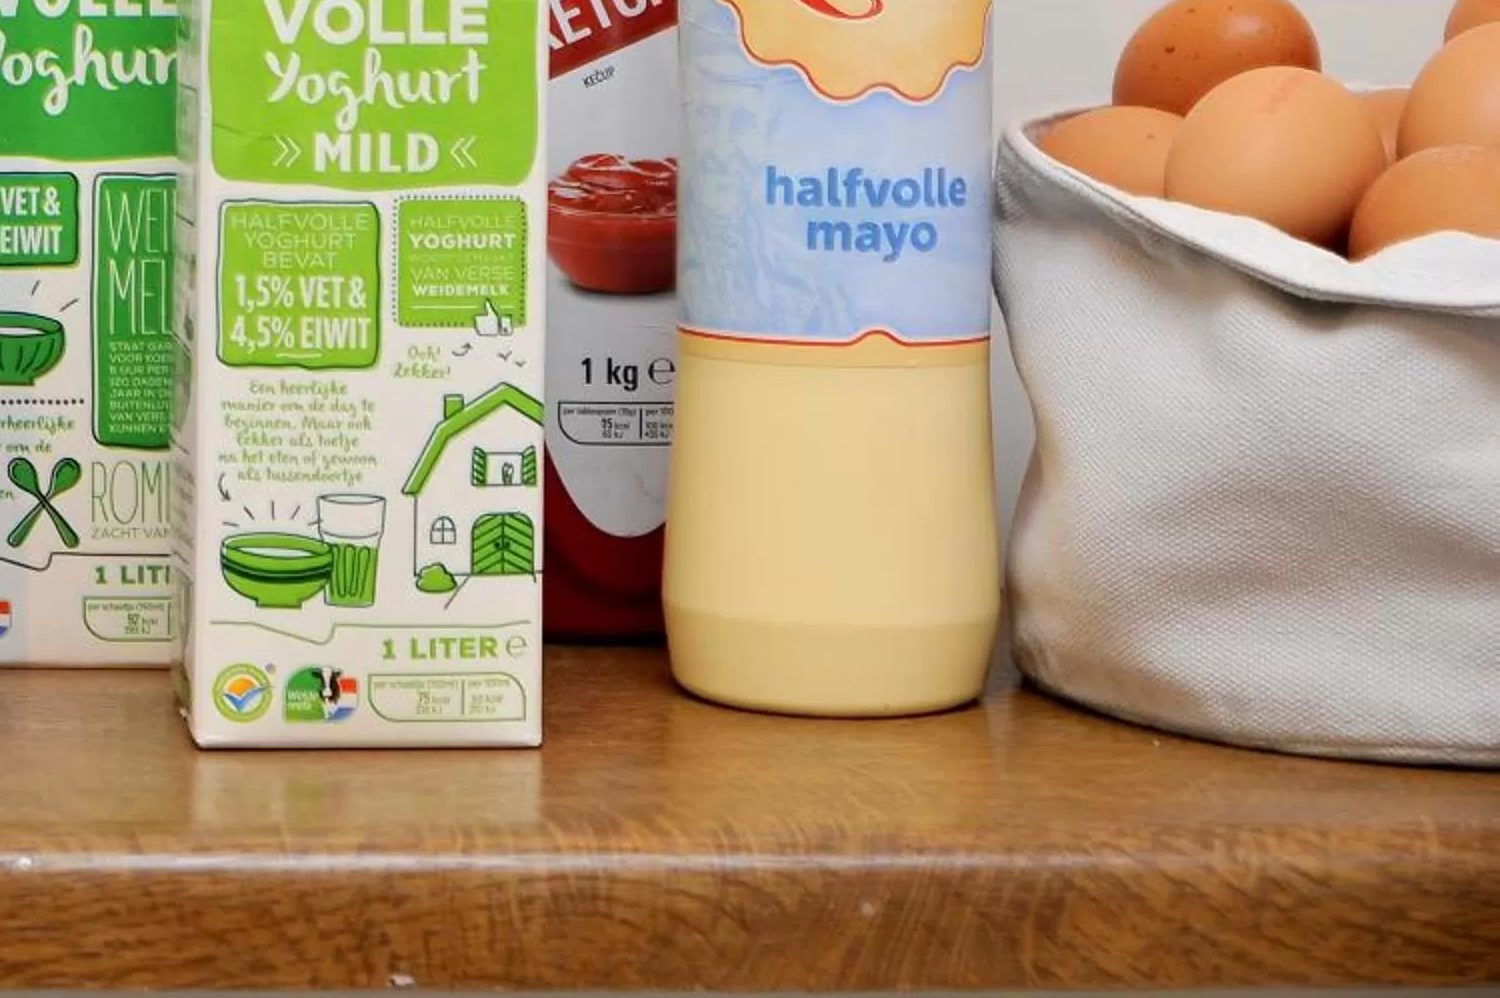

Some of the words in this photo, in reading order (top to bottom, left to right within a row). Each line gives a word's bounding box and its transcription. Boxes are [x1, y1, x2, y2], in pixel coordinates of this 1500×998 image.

[264, 47, 488, 131] Yoghurt
[313, 132, 440, 173] MILD
[765, 165, 967, 207] halfvolle
[0, 186, 40, 215] VET
[43, 186, 61, 215] &
[105, 188, 177, 253] WEI
[230, 213, 369, 231] HALFVOLLE
[0, 225, 63, 254] EIWIT
[244, 232, 357, 250] YOGHURT
[407, 233, 516, 250] YOGHURT
[806, 220, 938, 263] mayo
[263, 251, 338, 269] BEVAT
[411, 266, 449, 282] VAN
[234, 274, 294, 312] 1,5%
[299, 275, 345, 308] VET
[349, 275, 366, 308] &
[412, 283, 509, 298] WEIDEMELK
[229, 314, 295, 354] 4,5%
[300, 316, 371, 349] EIWIT
[581, 357, 592, 385] 1
[606, 357, 639, 392] kg
[280, 379, 348, 400] heerlijke
[220, 399, 275, 412] manier
[5, 442, 31, 453] om
[35, 439, 53, 453] de
[91, 527, 141, 540] ZACHT
[94, 565, 108, 585] 1
[381, 637, 397, 660] 1
[410, 636, 498, 660] LITER
